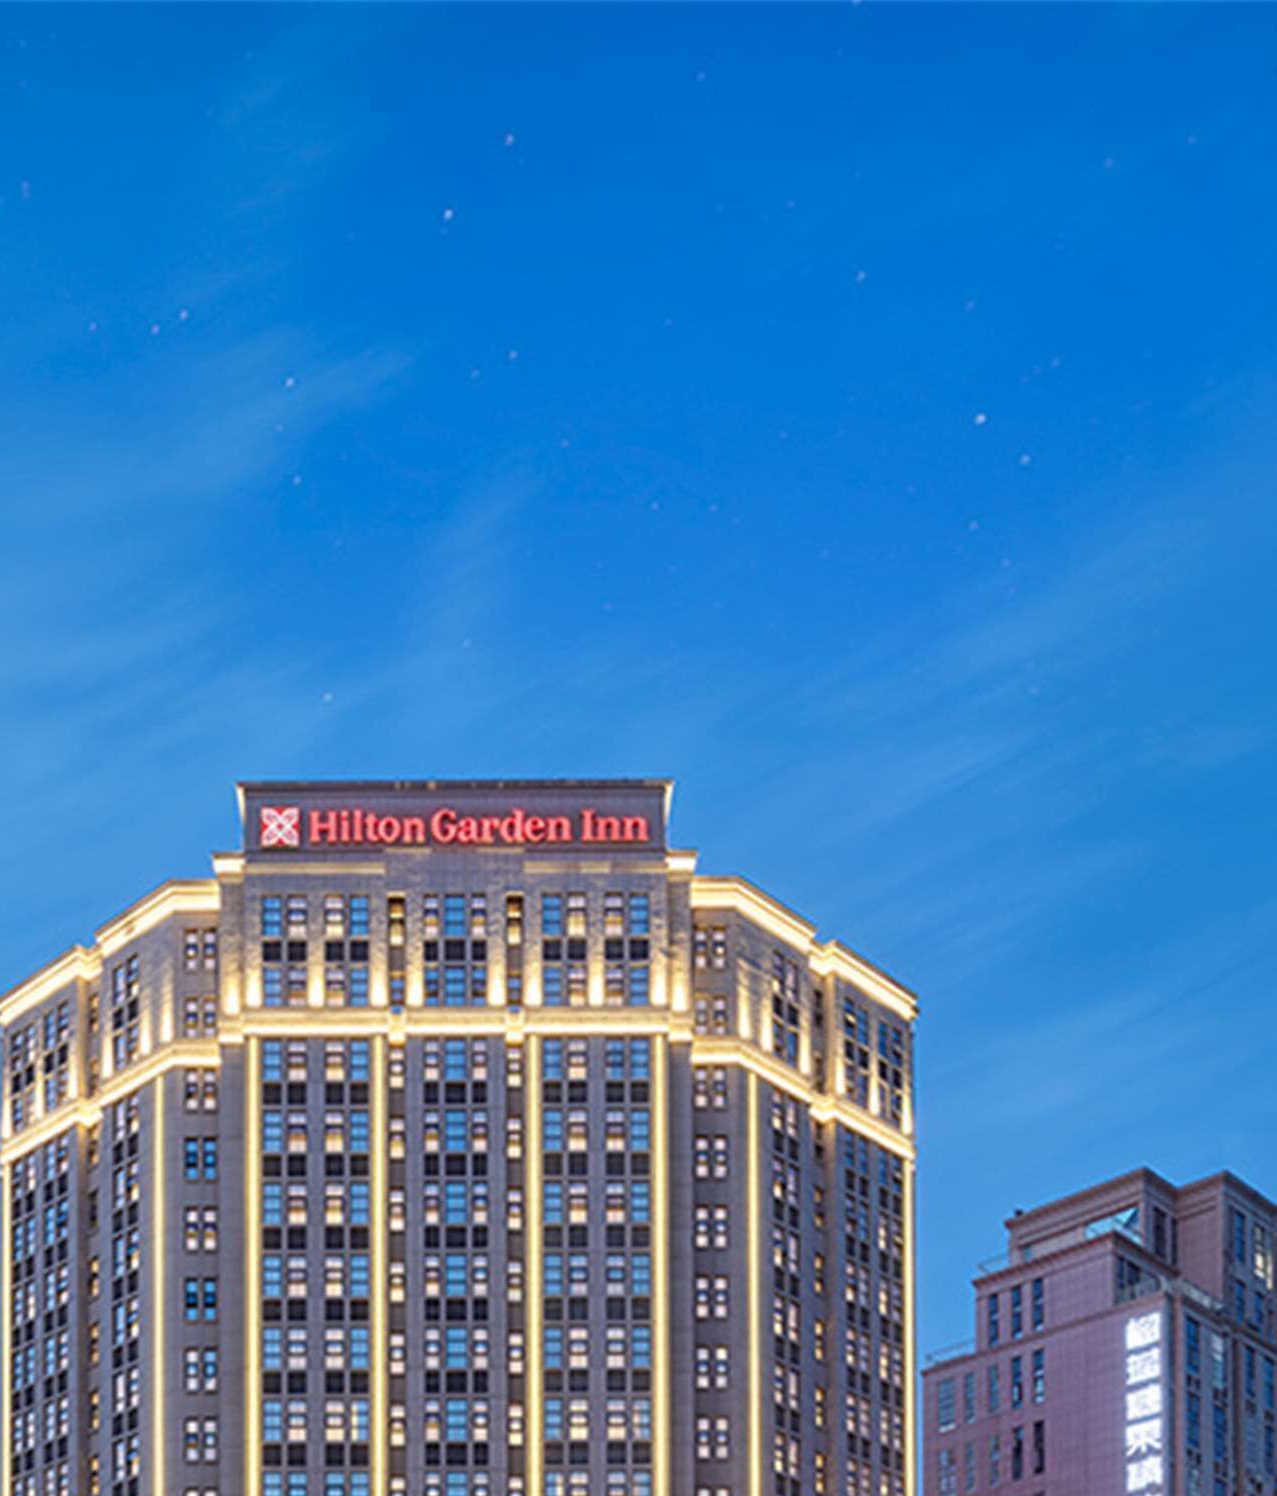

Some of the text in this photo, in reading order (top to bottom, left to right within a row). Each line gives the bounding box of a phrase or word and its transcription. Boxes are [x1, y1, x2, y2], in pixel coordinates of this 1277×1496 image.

[308, 808, 650, 843] Hilton Garden Inn
